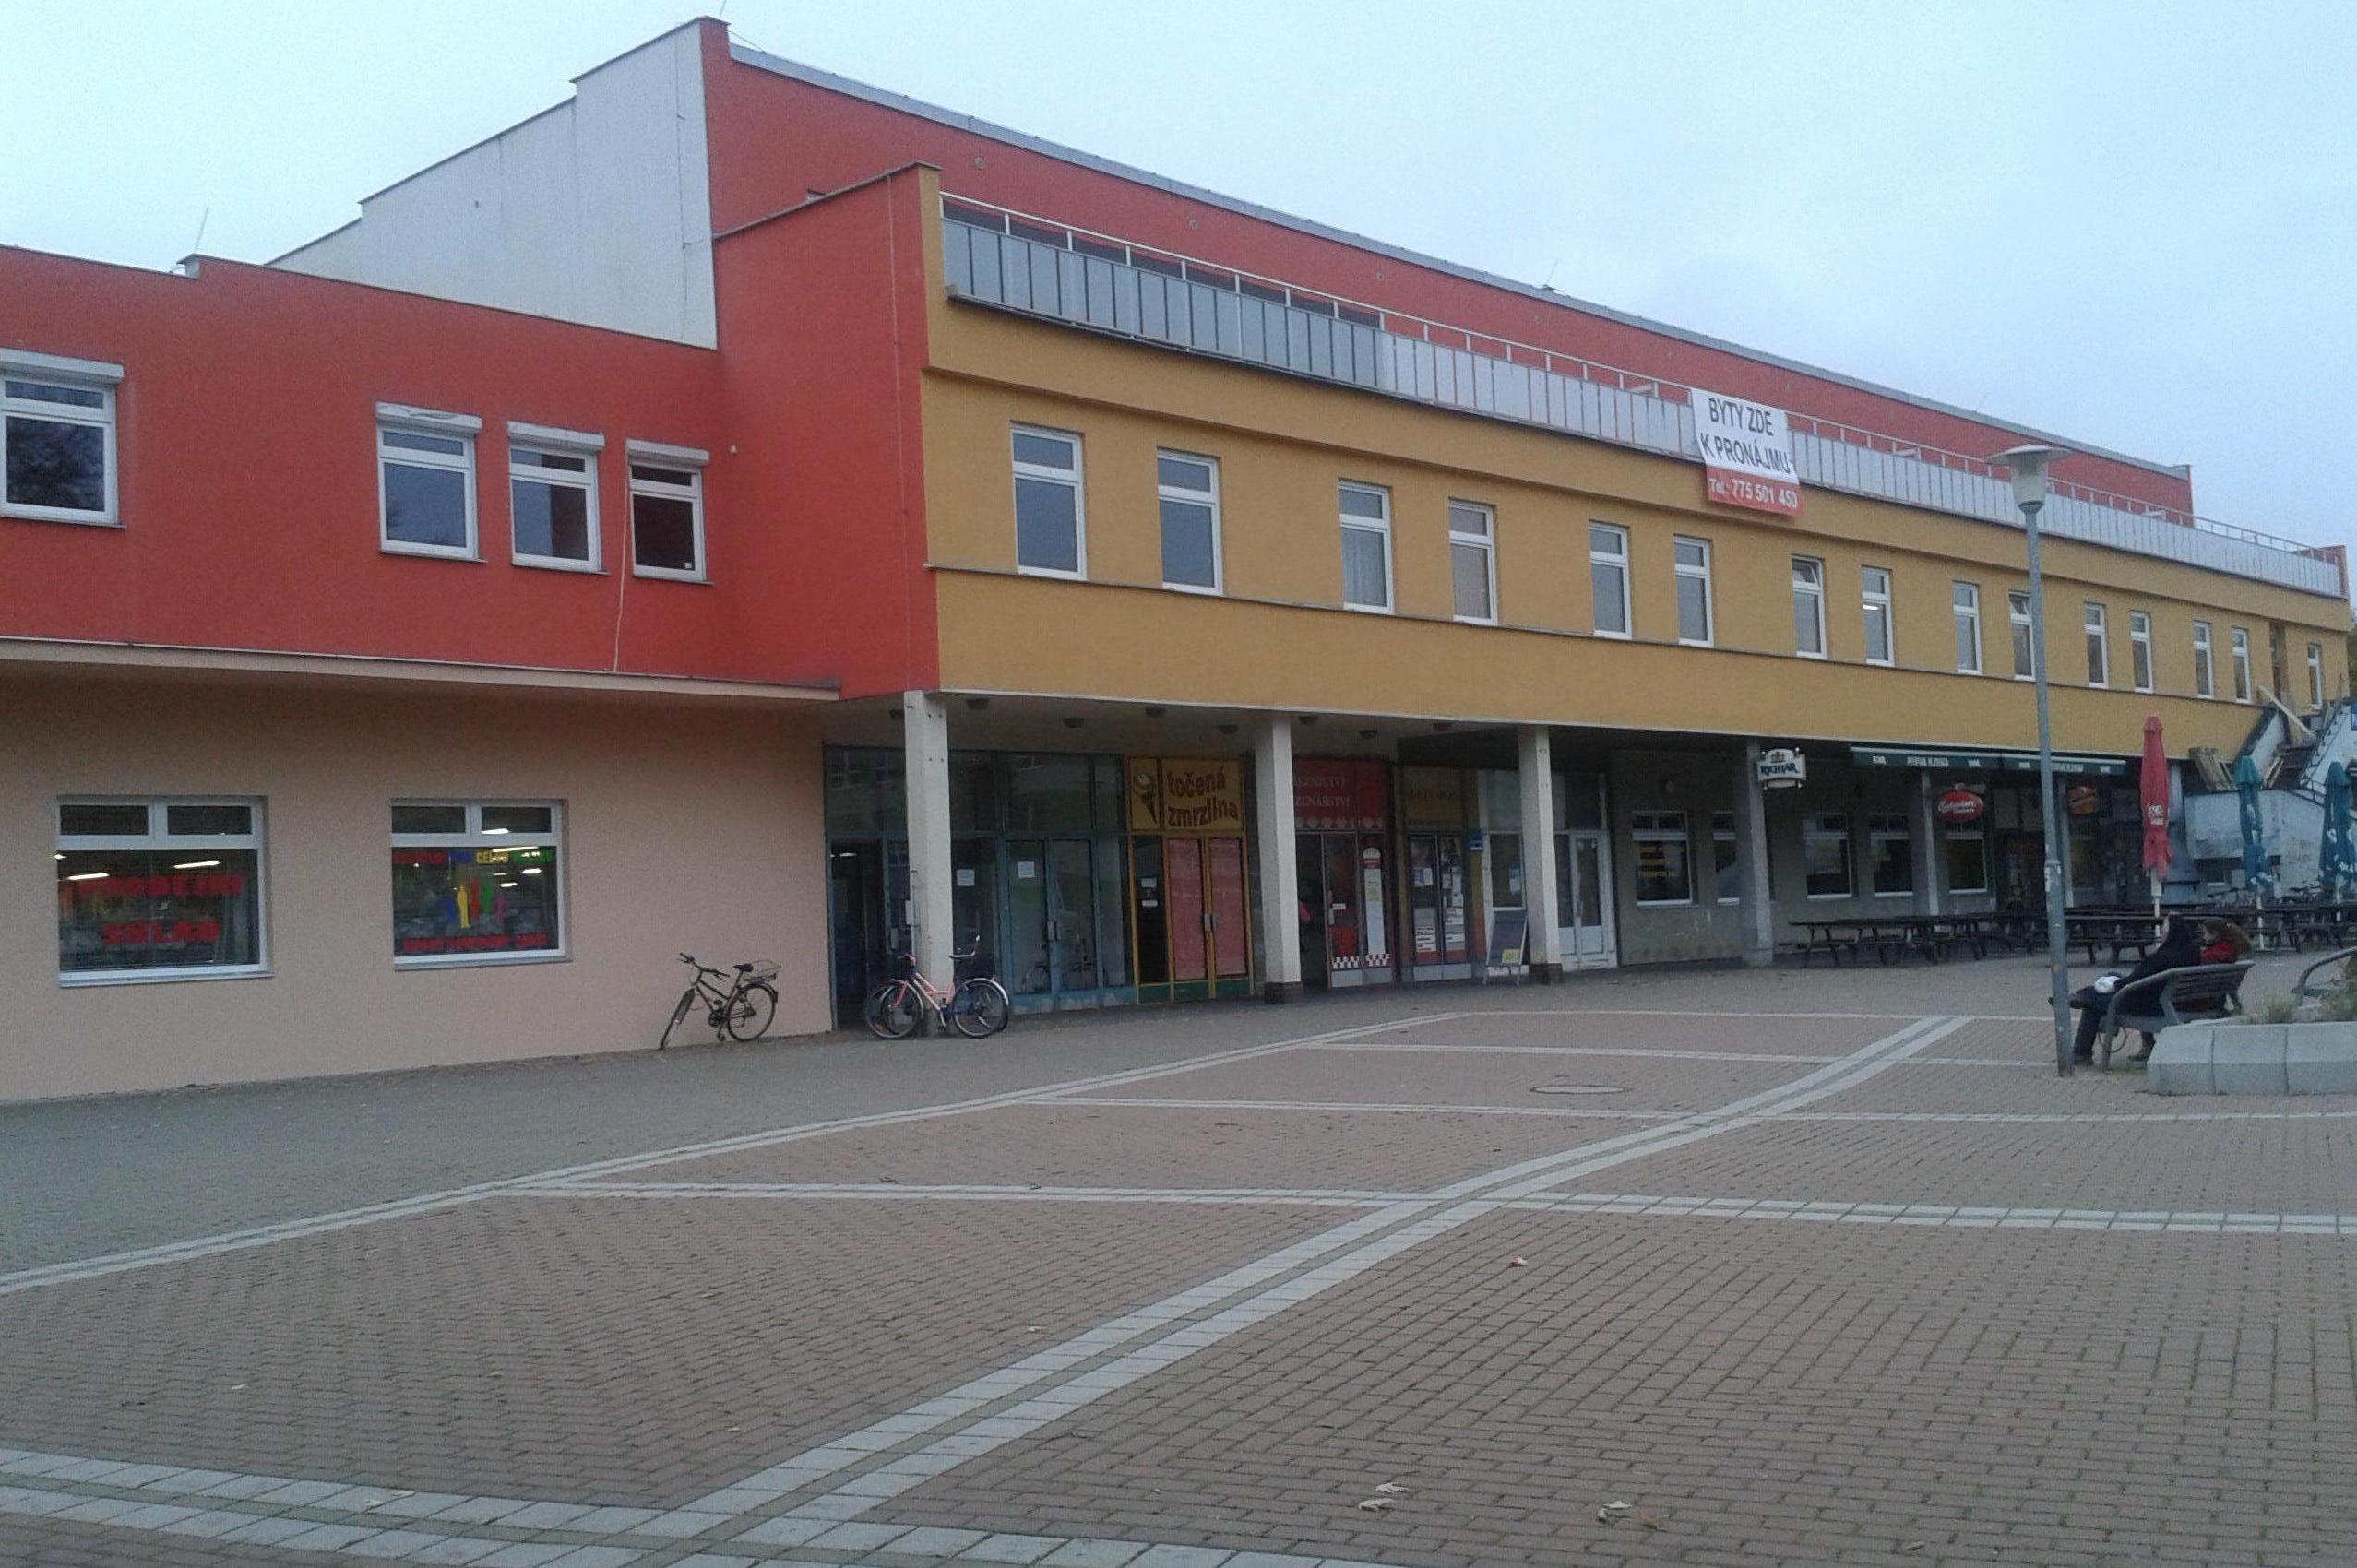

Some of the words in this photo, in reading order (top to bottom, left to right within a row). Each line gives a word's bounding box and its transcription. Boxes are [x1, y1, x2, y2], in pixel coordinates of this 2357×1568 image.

[1708, 397, 1743, 429] BYTY
[1746, 407, 1774, 436] ZDE
[1700, 433, 1714, 458] K
[1714, 435, 1791, 474] PRONÁJMU
[1732, 478, 1753, 499] 775
[1756, 484, 1775, 504] 501
[1166, 766, 1226, 797] točená
[1167, 796, 1239, 827] zmrzlina
